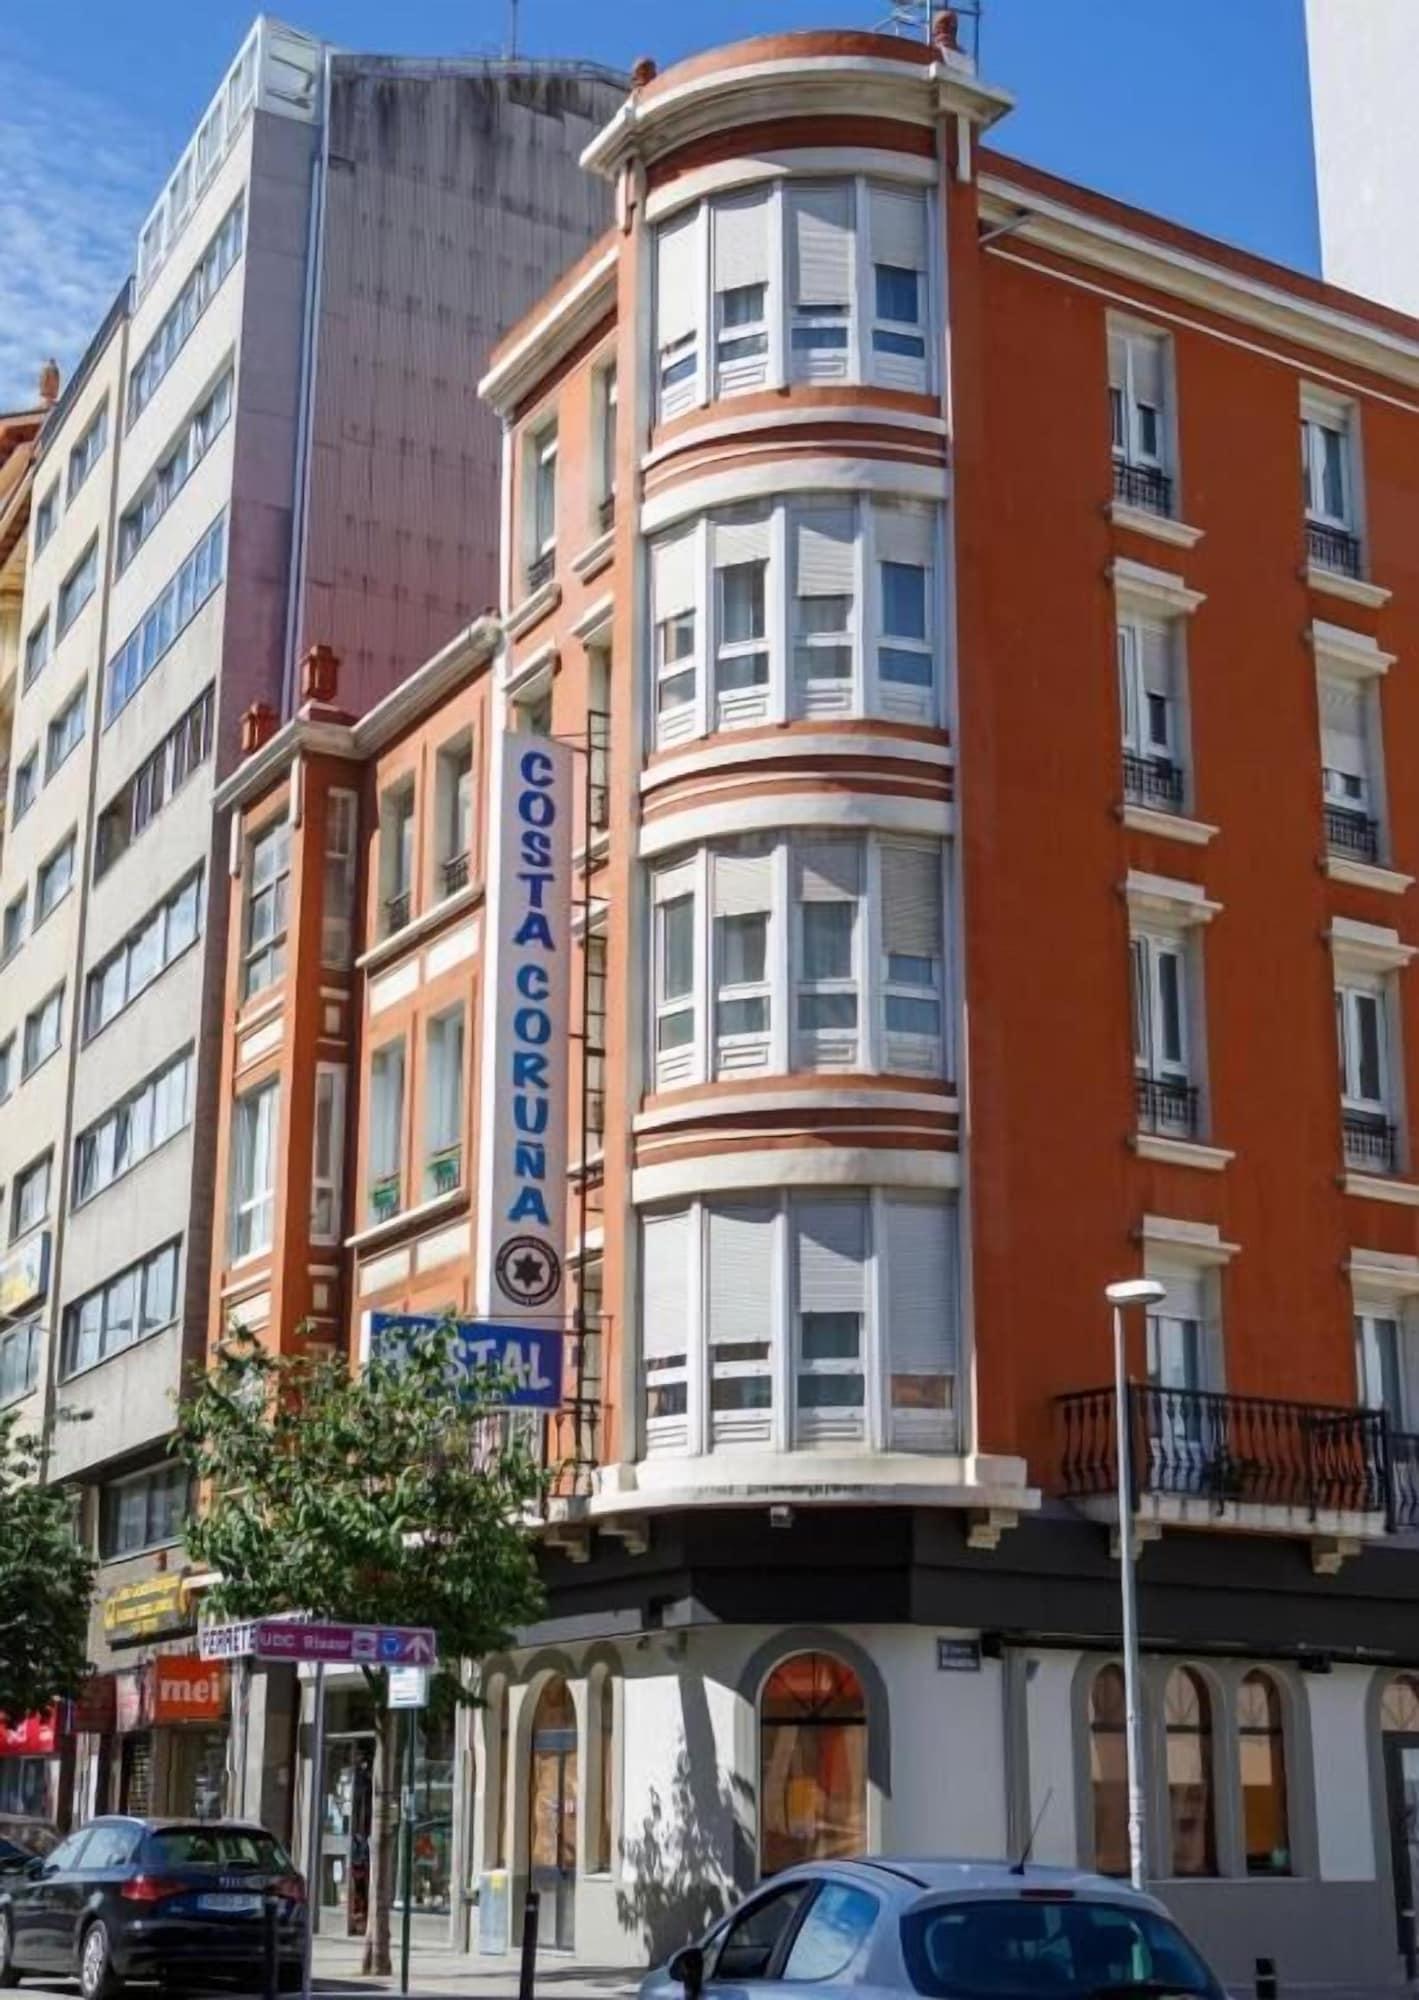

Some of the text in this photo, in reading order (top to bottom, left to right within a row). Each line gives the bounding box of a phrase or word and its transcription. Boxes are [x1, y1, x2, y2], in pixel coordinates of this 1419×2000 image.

[507, 751, 556, 1226] COSTA CORUÑA
[379, 1328, 551, 1390] HSTAL
